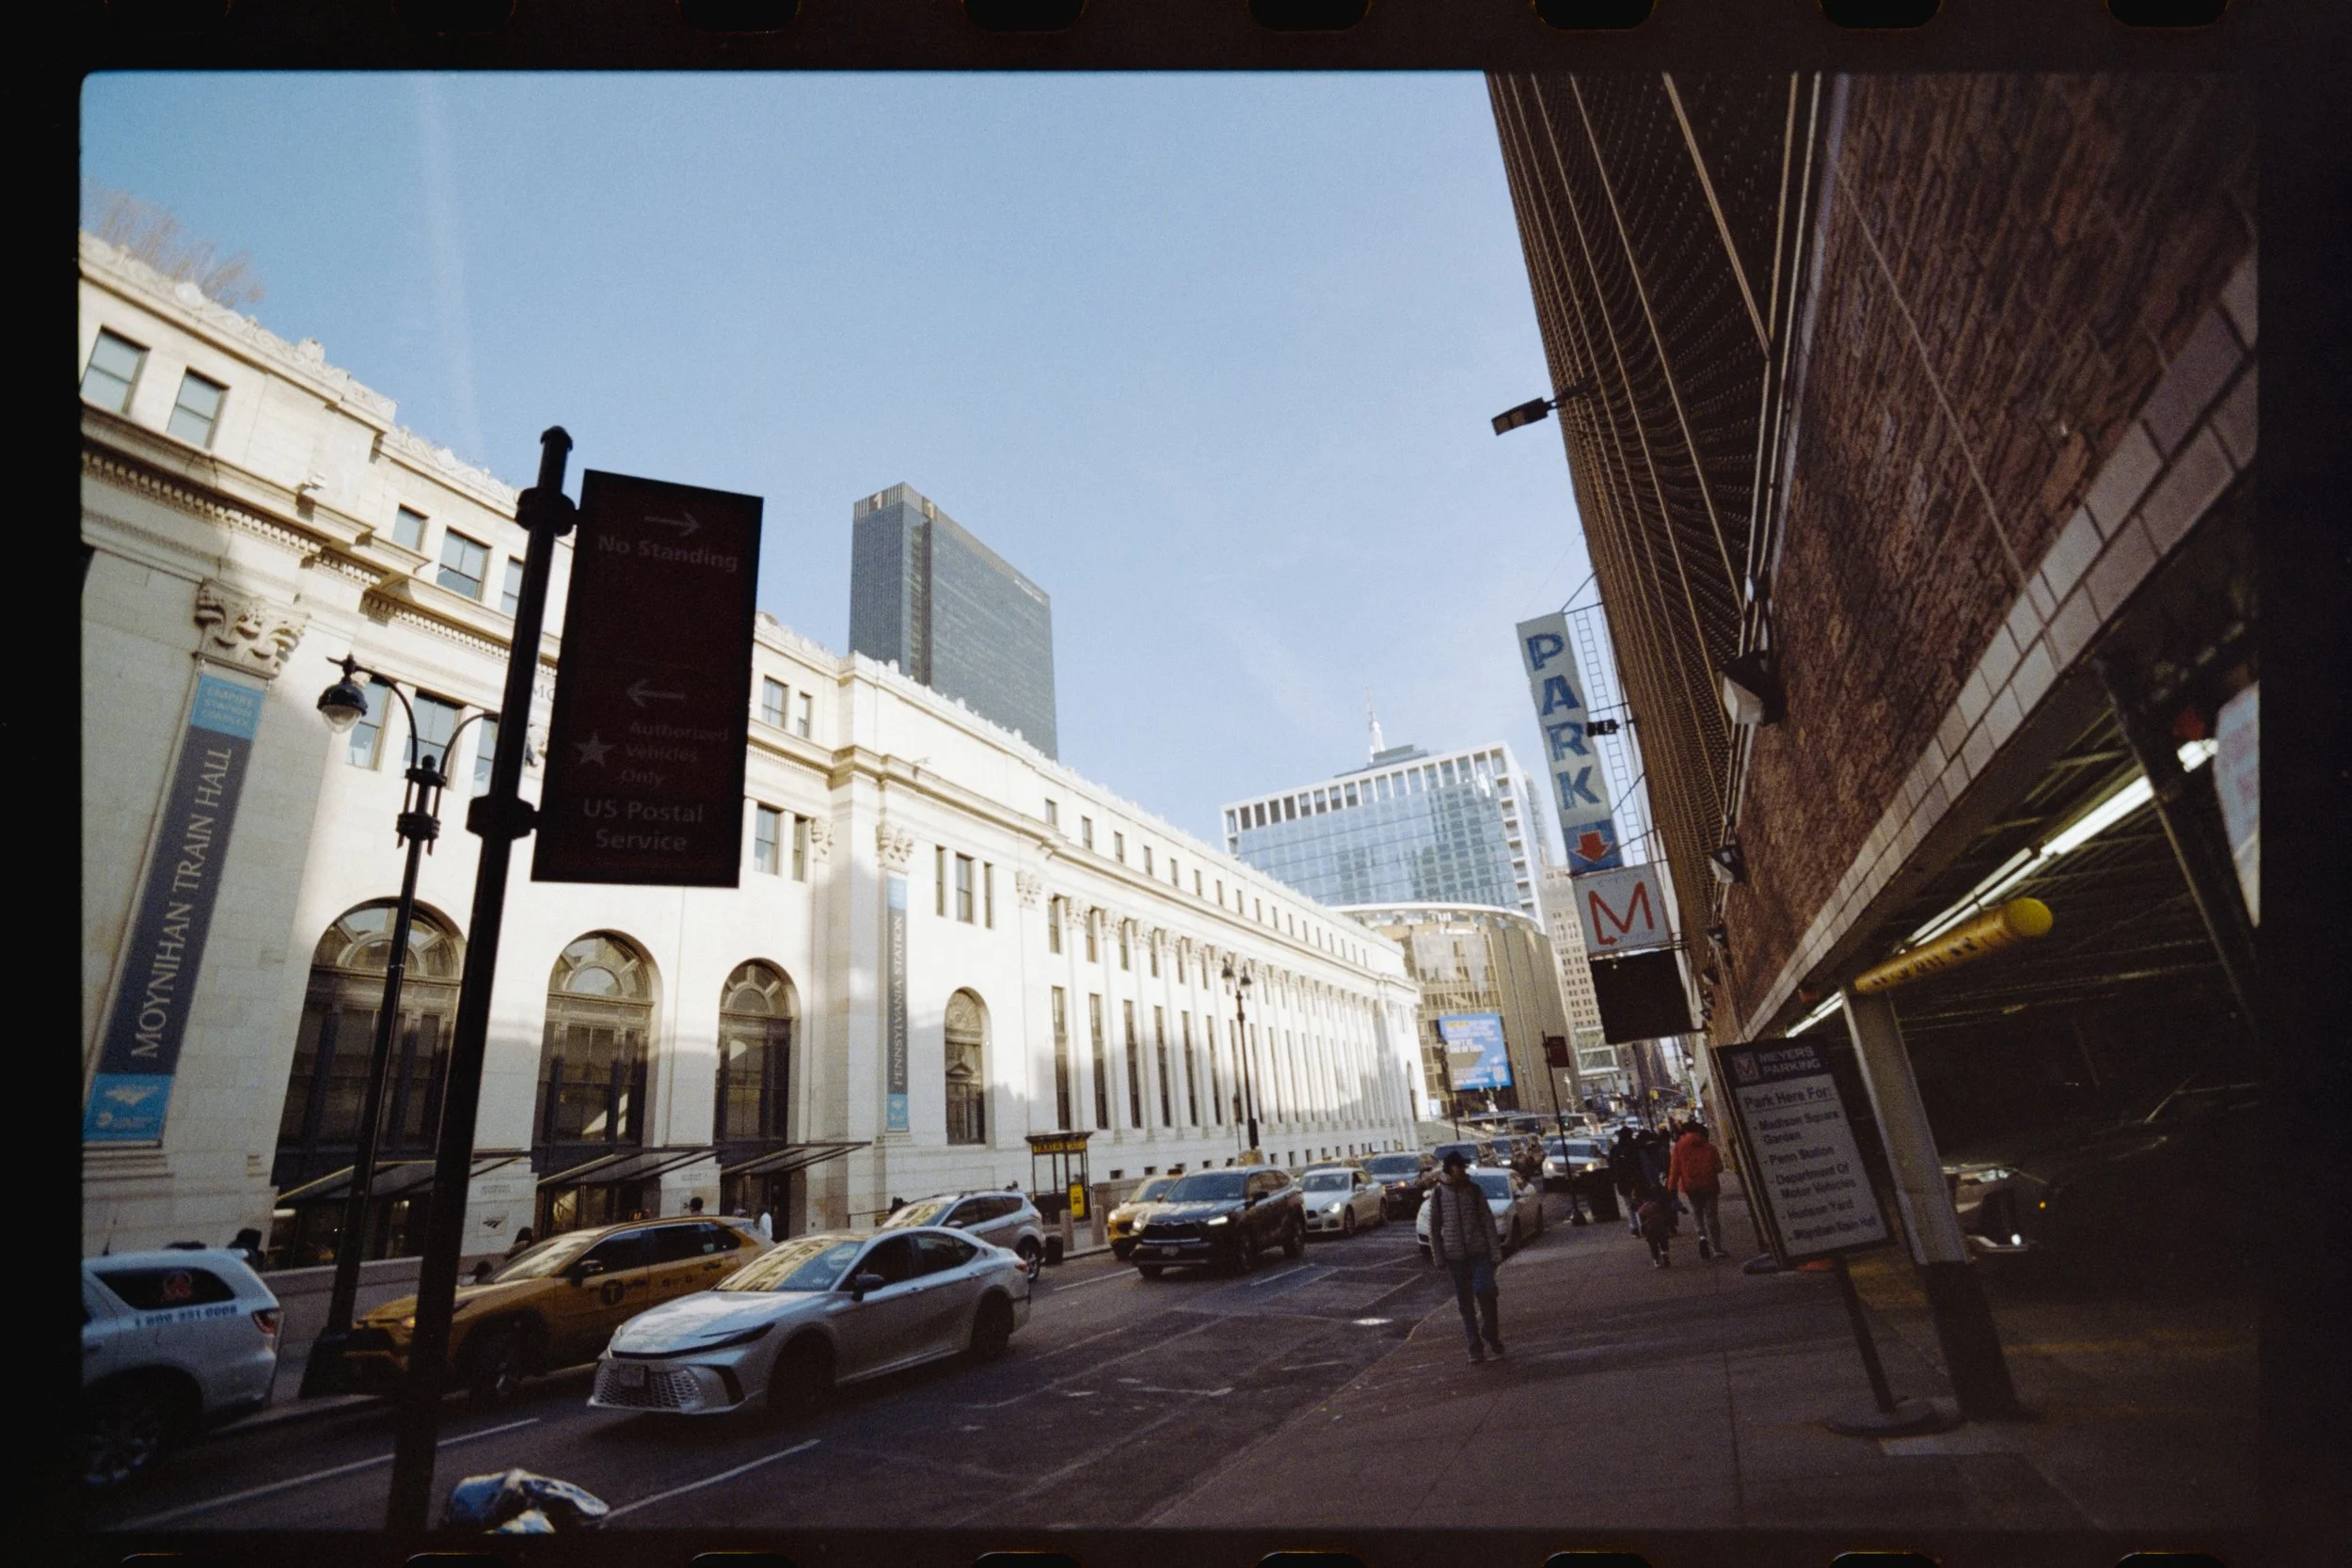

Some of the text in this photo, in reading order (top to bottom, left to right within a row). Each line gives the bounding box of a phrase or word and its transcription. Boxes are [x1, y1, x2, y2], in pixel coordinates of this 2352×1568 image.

[598, 534, 738, 573] No Standing
[1526, 631, 1600, 809] PARK
[630, 721, 729, 741] Authorized
[626, 744, 699, 763] Vehicles
[620, 768, 665, 789] Only
[583, 799, 704, 824] US Postal
[596, 829, 688, 852] Service
[131, 749, 232, 1058] MOYNIHAN TRAIN HALL
[895, 916, 903, 973] STATION
[895, 978, 903, 1086] PENNSYLVANIA
[1758, 1046, 1815, 1063] MEYERS
[1763, 1058, 1821, 1075] PARKING
[1744, 1095, 1774, 1110] Park
[1775, 1091, 1806, 1104] Here
[1758, 1110, 1840, 1131] Madison Square
[1763, 1132, 1802, 1146] Garden
[1769, 1146, 1835, 1166] Penn Station
[1775, 1166, 1836, 1185] Department
[1780, 1179, 1857, 1198] Motor Vehicles
[1787, 1207, 1828, 1221] Hudson
